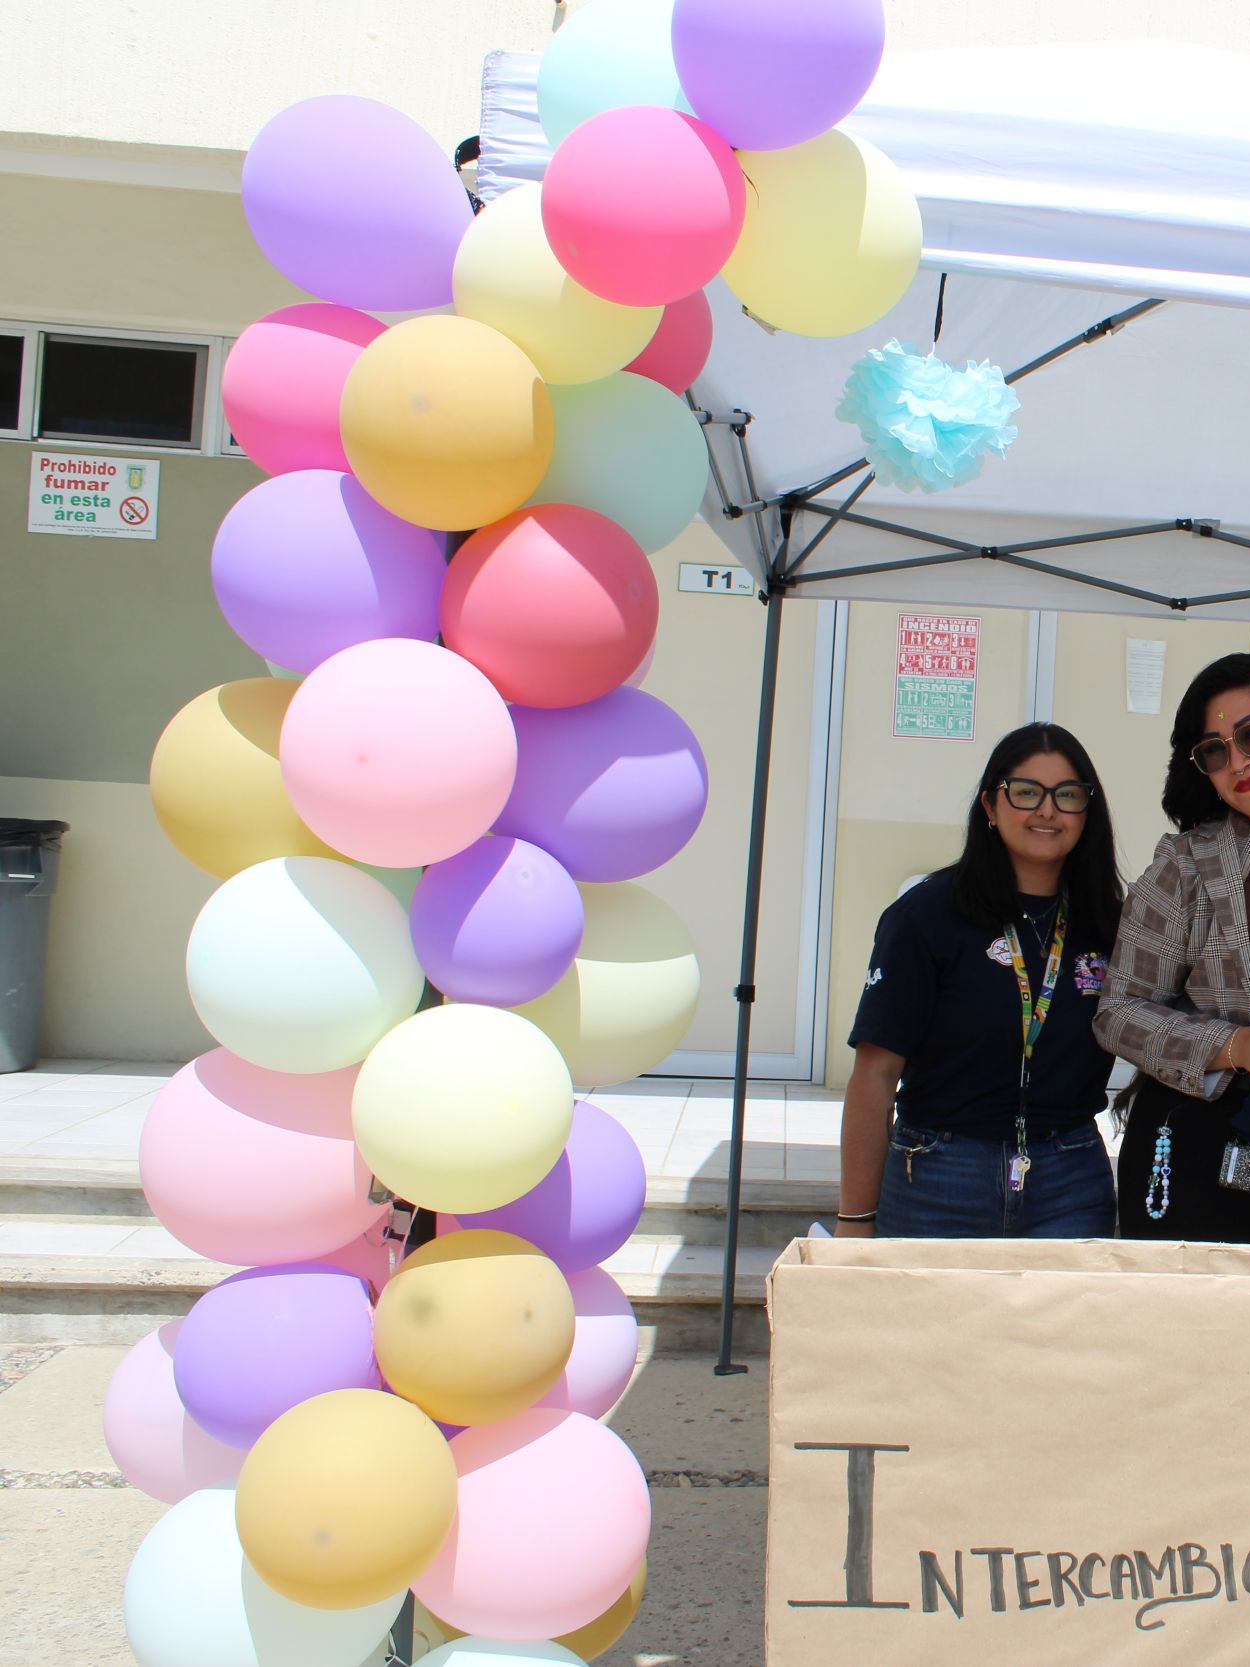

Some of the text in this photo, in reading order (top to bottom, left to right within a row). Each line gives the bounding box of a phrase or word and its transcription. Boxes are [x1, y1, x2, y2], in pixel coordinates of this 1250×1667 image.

[40, 458, 117, 476] Prohibido
[44, 475, 110, 492] fumar
[41, 493, 112, 508] en esta
[54, 507, 97, 522] área
[702, 569, 733, 589] T1
[901, 621, 977, 633] INCENDIO
[926, 632, 933, 647] 2
[952, 633, 958, 648] 3
[900, 653, 957, 670] 4 5 6
[904, 682, 968, 693] SISMOS
[949, 693, 955, 707] 3
